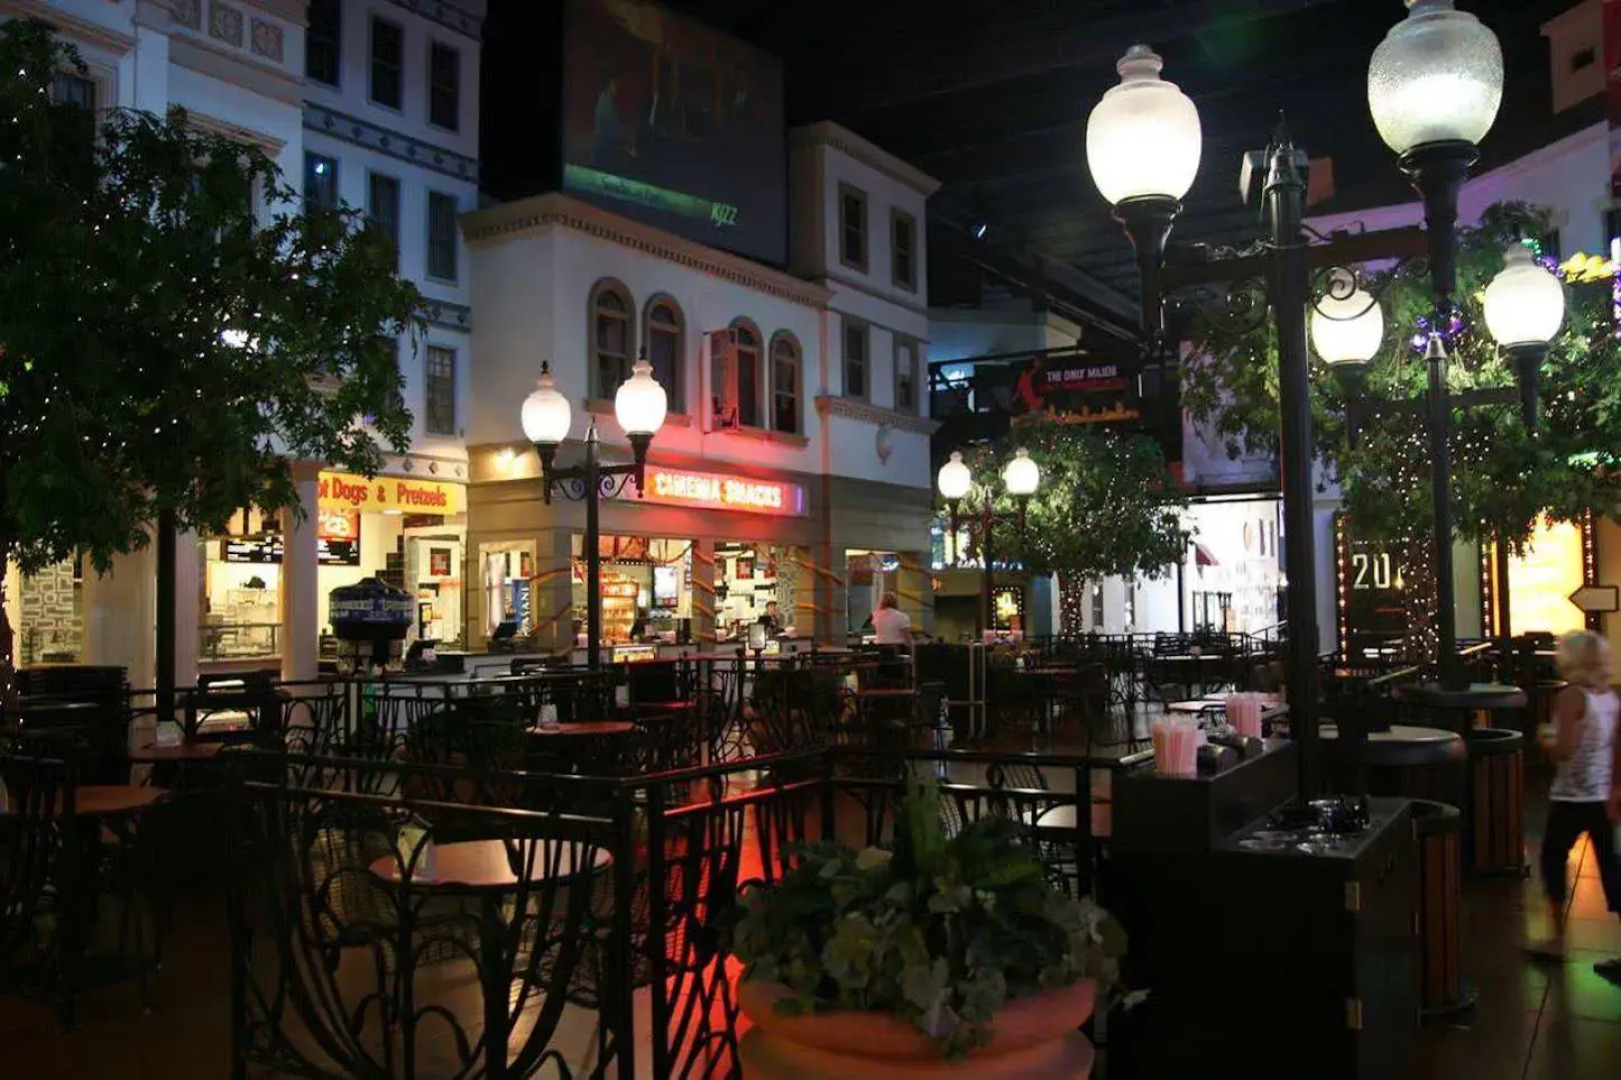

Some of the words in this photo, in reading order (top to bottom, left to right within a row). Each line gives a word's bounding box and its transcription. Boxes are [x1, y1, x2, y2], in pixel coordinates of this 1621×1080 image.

[1046, 371, 1062, 382] THE
[1064, 368, 1086, 382] ONLY
[1087, 365, 1118, 379] MAJOR
[317, 479, 329, 499] ot
[332, 476, 368, 506] Dogs
[376, 484, 387, 503] &
[396, 482, 448, 508] Pretzels
